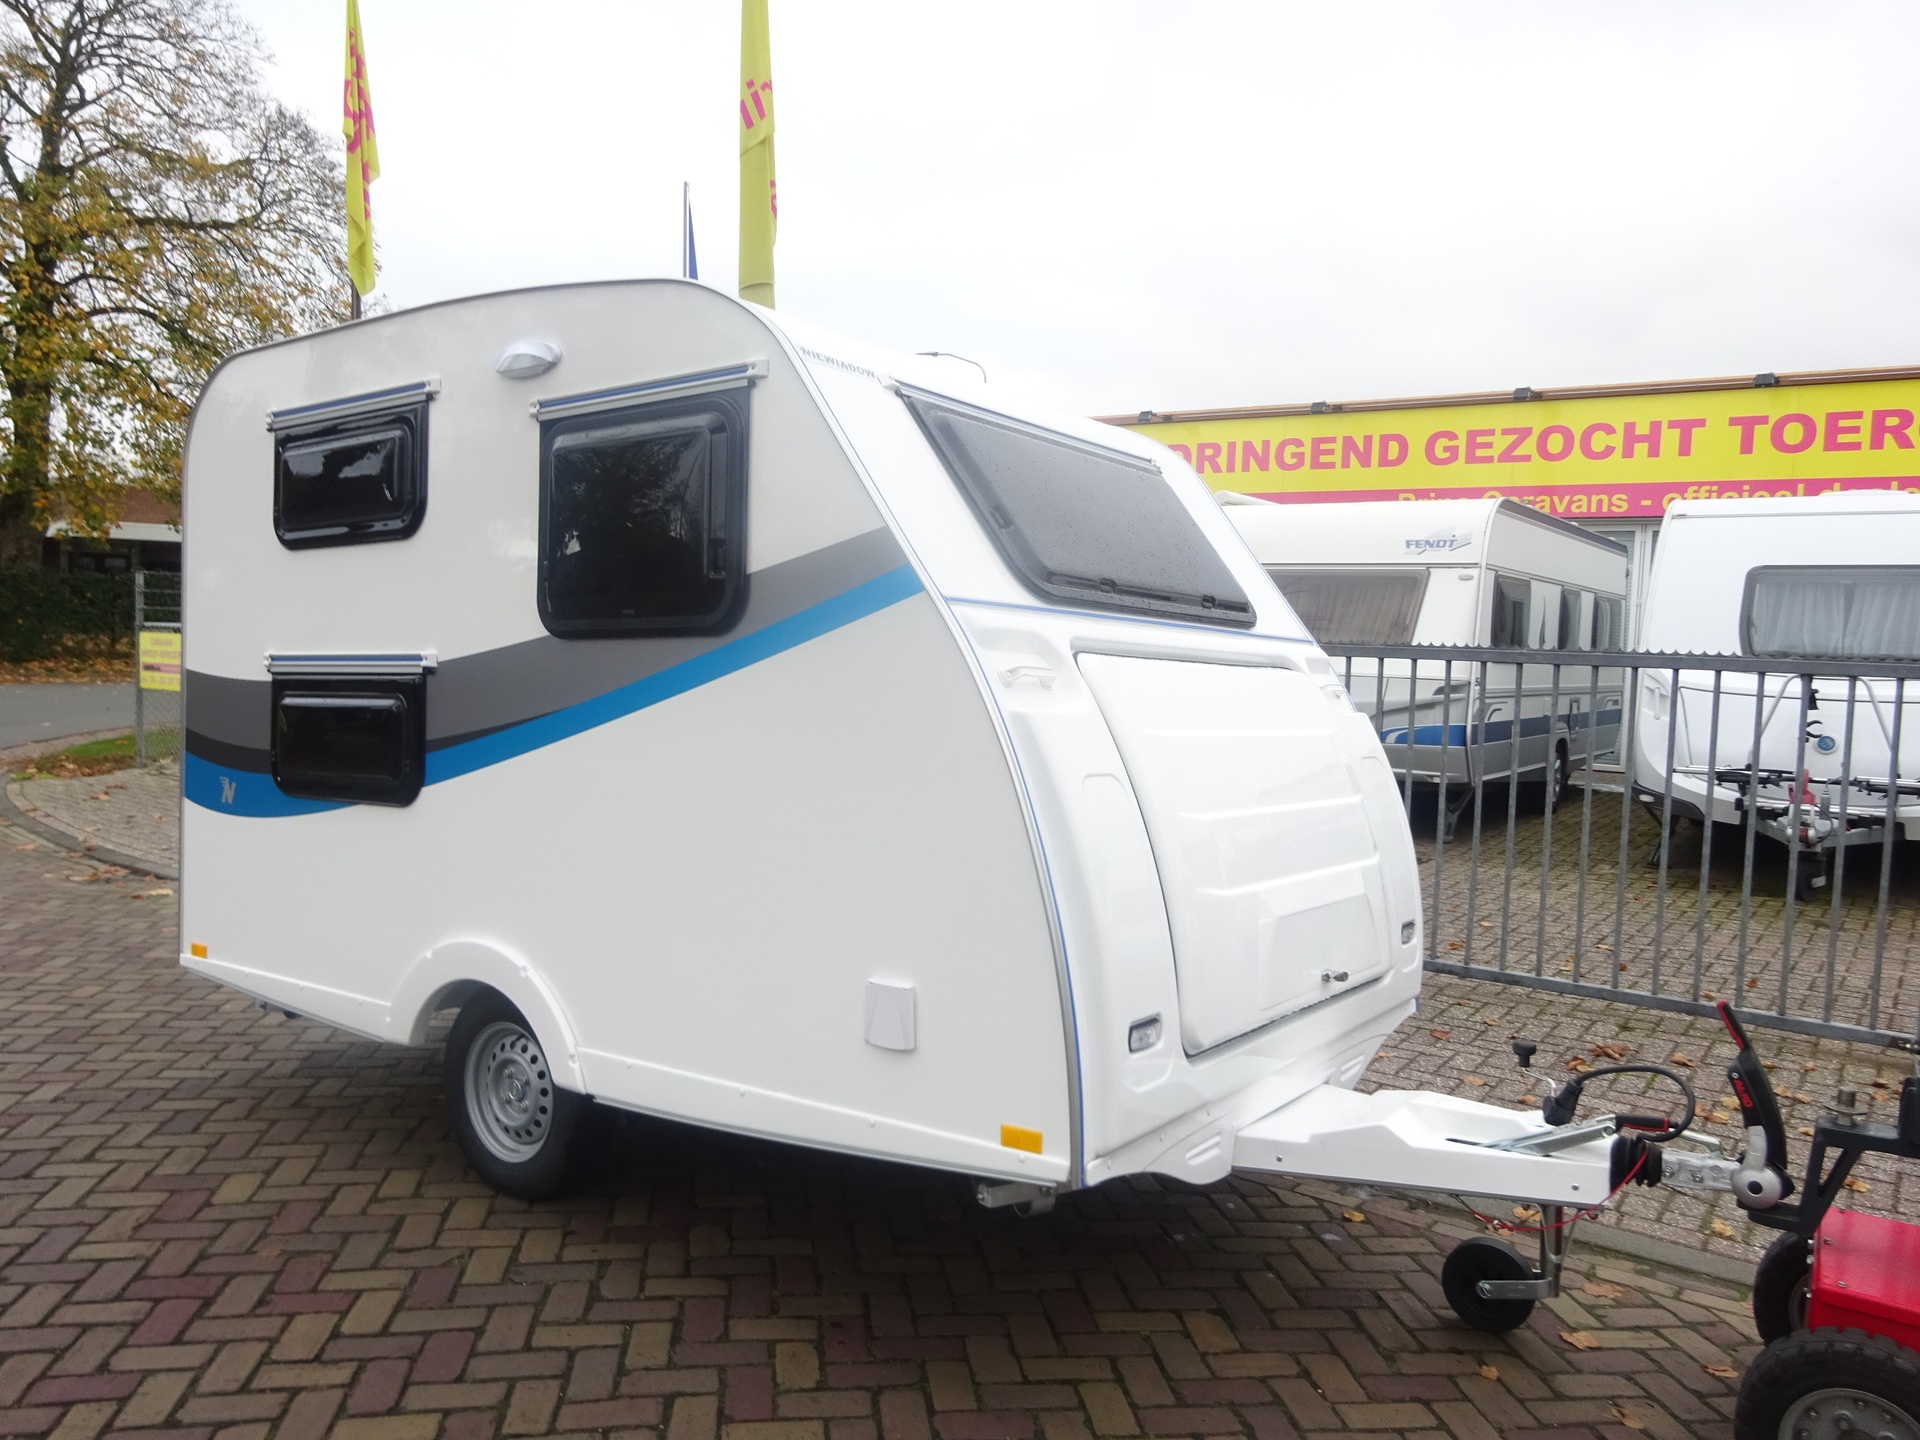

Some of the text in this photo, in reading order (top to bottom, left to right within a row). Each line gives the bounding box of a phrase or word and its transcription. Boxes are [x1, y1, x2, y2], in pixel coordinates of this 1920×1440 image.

[1424, 418, 1706, 466] GEZOCHT
[1728, 408, 1920, 455] TOER
[1481, 490, 1628, 513] avans
[1405, 539, 1458, 549] FENDT
